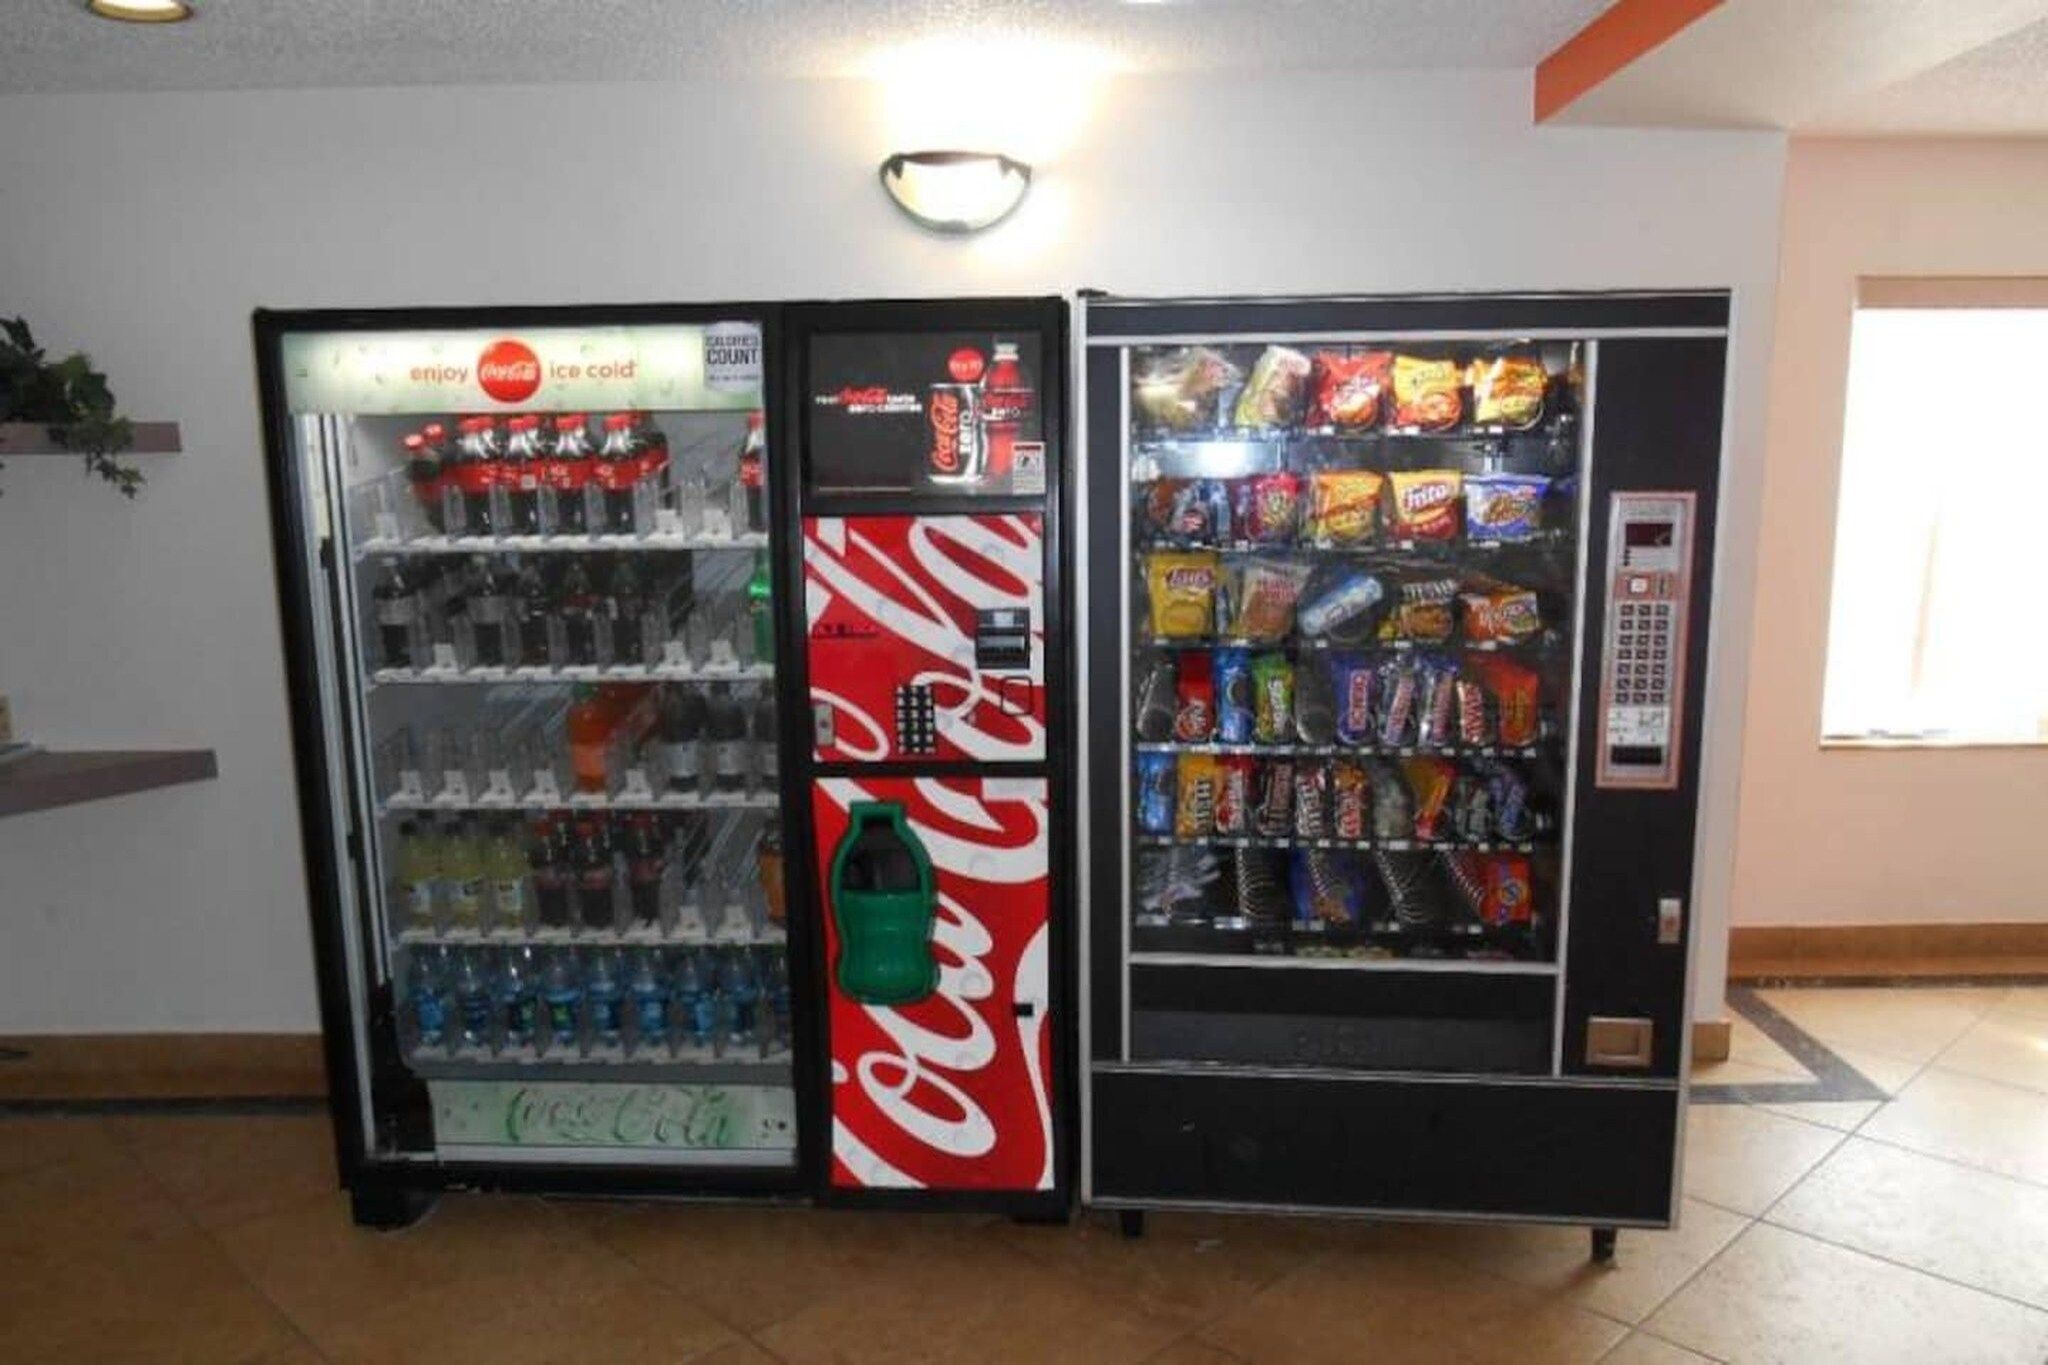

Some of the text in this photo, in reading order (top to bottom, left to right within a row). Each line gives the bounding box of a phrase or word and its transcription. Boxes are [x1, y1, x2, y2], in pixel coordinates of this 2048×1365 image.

[706, 348, 757, 365] COUNT
[409, 364, 469, 384] enjoy
[550, 362, 580, 379] ice
[585, 359, 637, 379] cold
